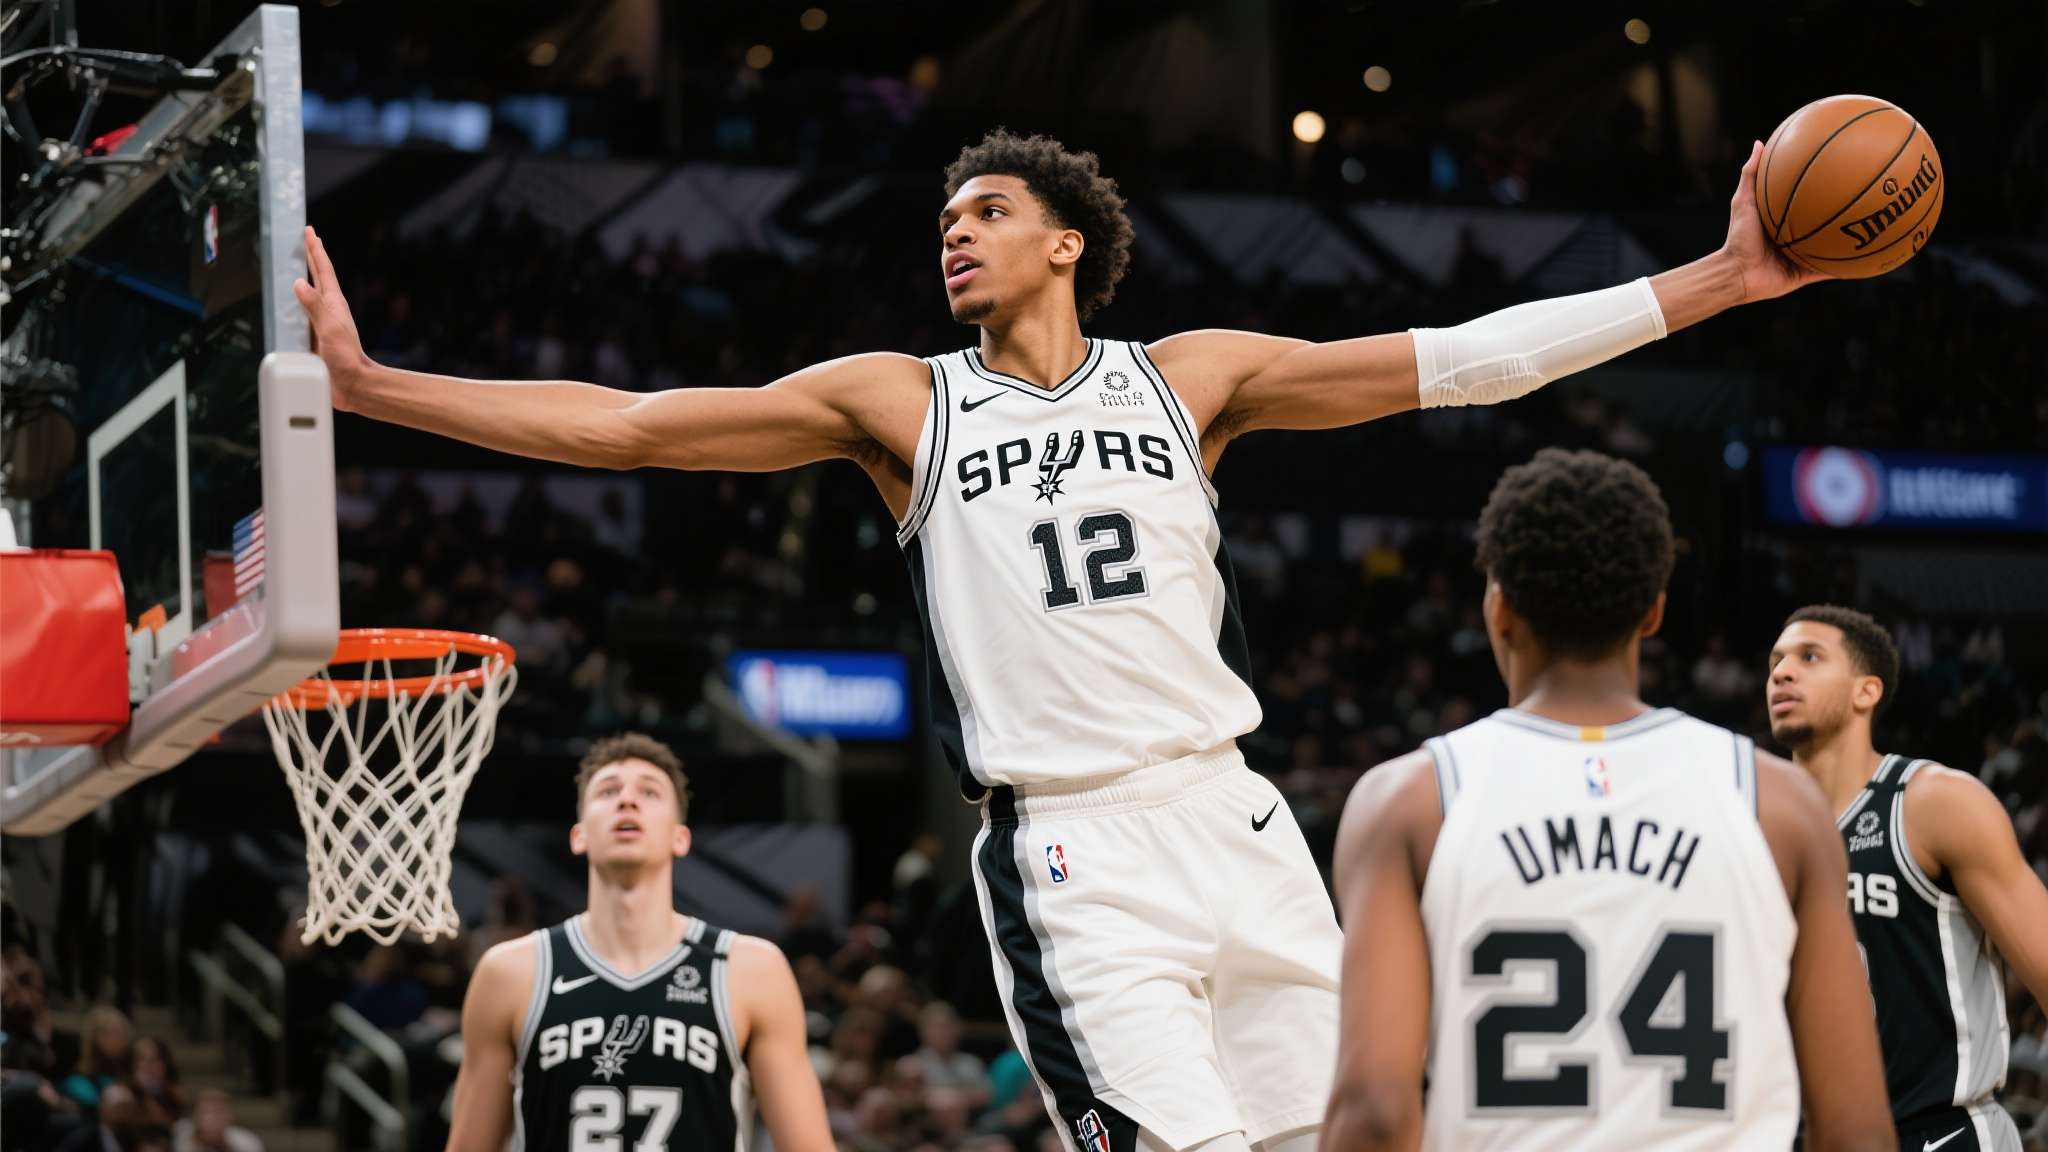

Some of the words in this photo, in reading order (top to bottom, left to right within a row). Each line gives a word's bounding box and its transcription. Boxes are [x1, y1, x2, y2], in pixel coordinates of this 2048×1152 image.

[957, 430, 1174, 506] SPURS
[1027, 508, 1150, 612] 12
[1500, 815, 1701, 890] UMACH
[1463, 918, 1737, 1119] 24
[568, 1084, 684, 1152] 27
